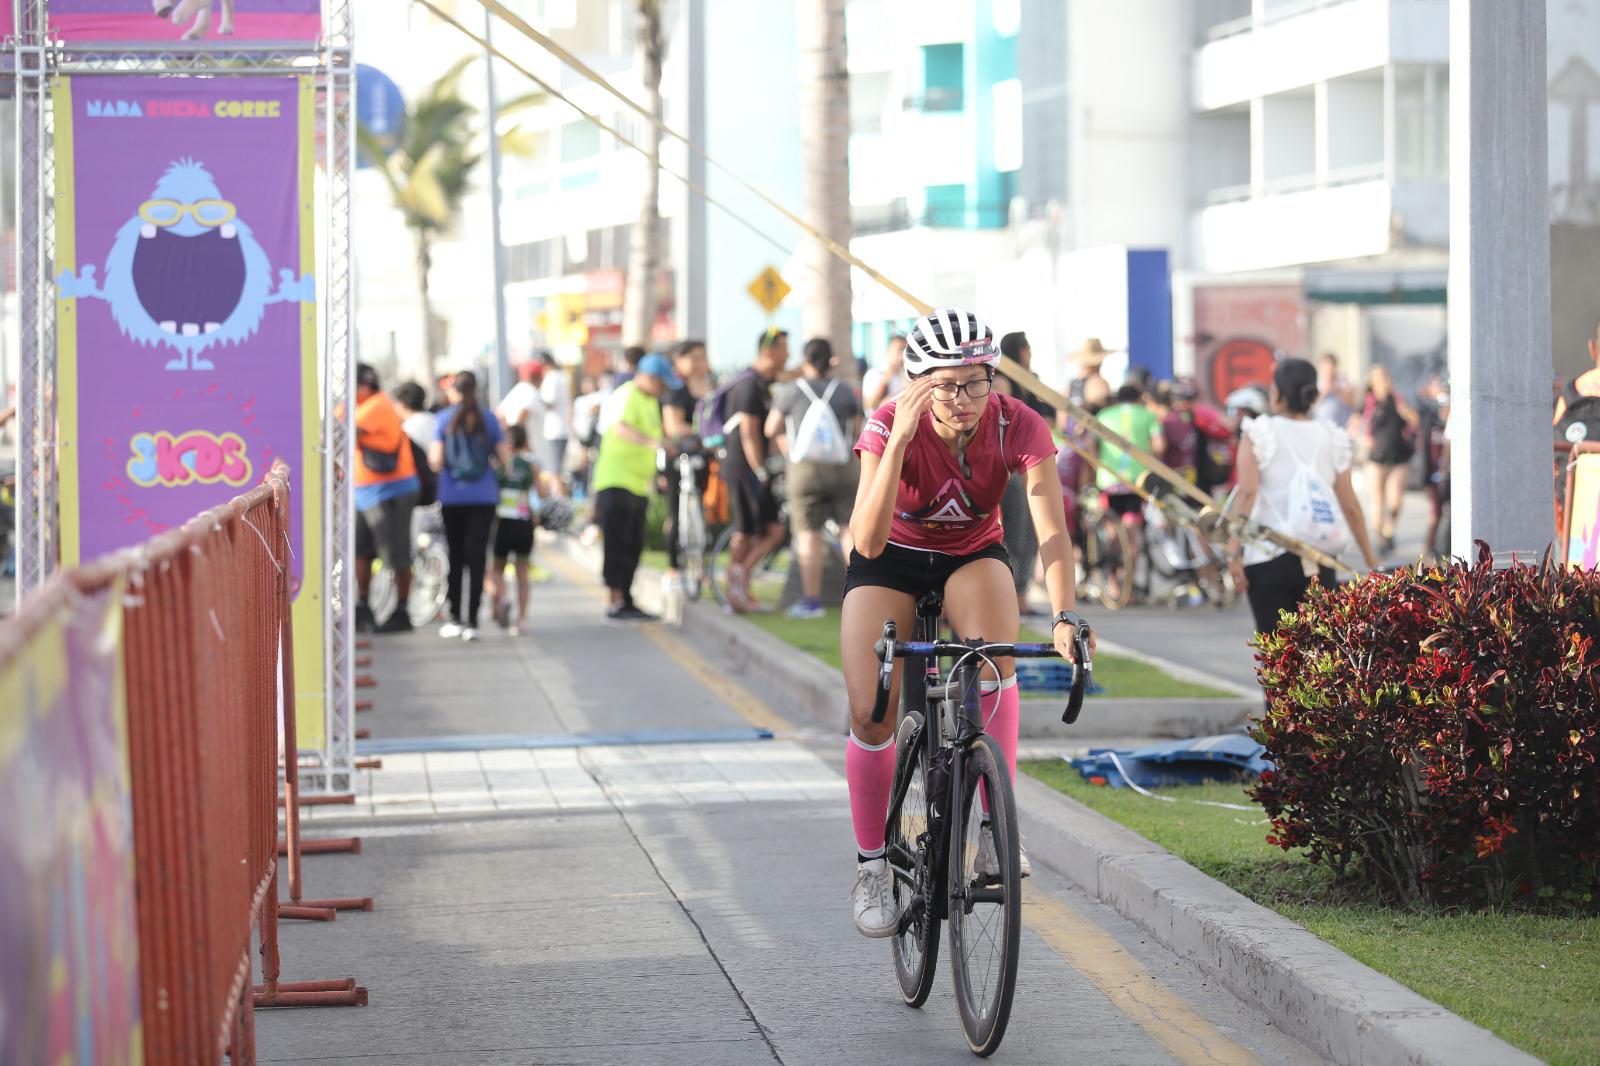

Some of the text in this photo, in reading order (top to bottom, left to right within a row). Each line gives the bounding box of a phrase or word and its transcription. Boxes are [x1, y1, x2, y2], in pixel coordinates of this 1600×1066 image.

[87, 100, 281, 118] NADA RUEDA CORRE
